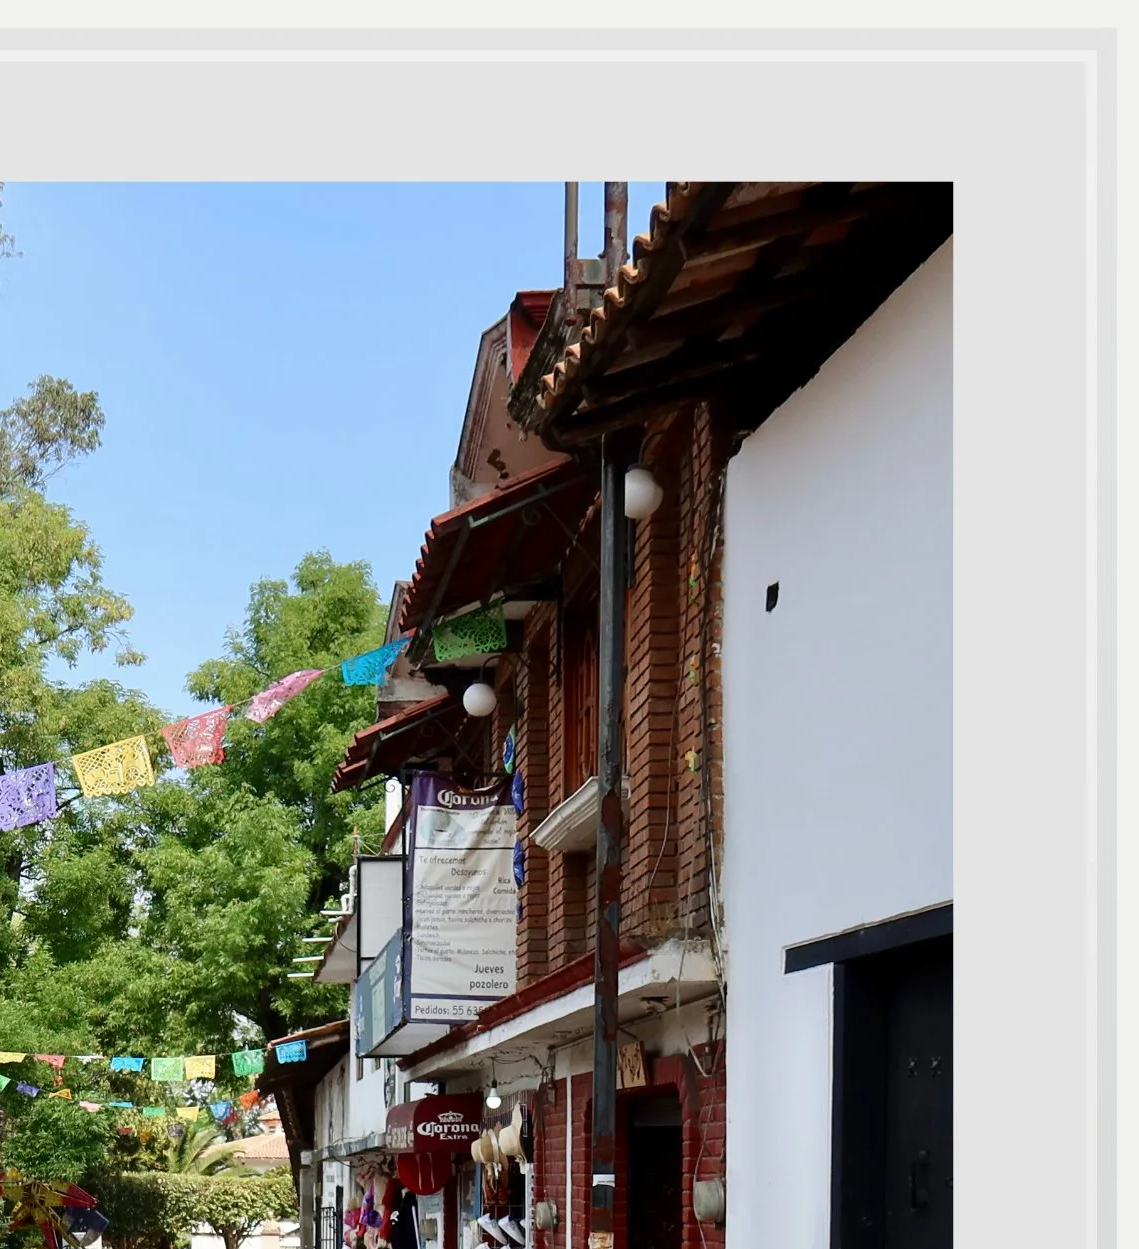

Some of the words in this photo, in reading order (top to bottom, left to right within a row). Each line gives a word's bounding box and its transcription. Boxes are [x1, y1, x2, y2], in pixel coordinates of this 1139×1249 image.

[493, 887, 516, 895] Comida
[474, 964, 504, 973] Jueves
[469, 979, 509, 991] pozolero
[415, 1005, 450, 1015] Pedidos:
[452, 1005, 464, 1015] 55
[417, 1121, 481, 1137] Corona
